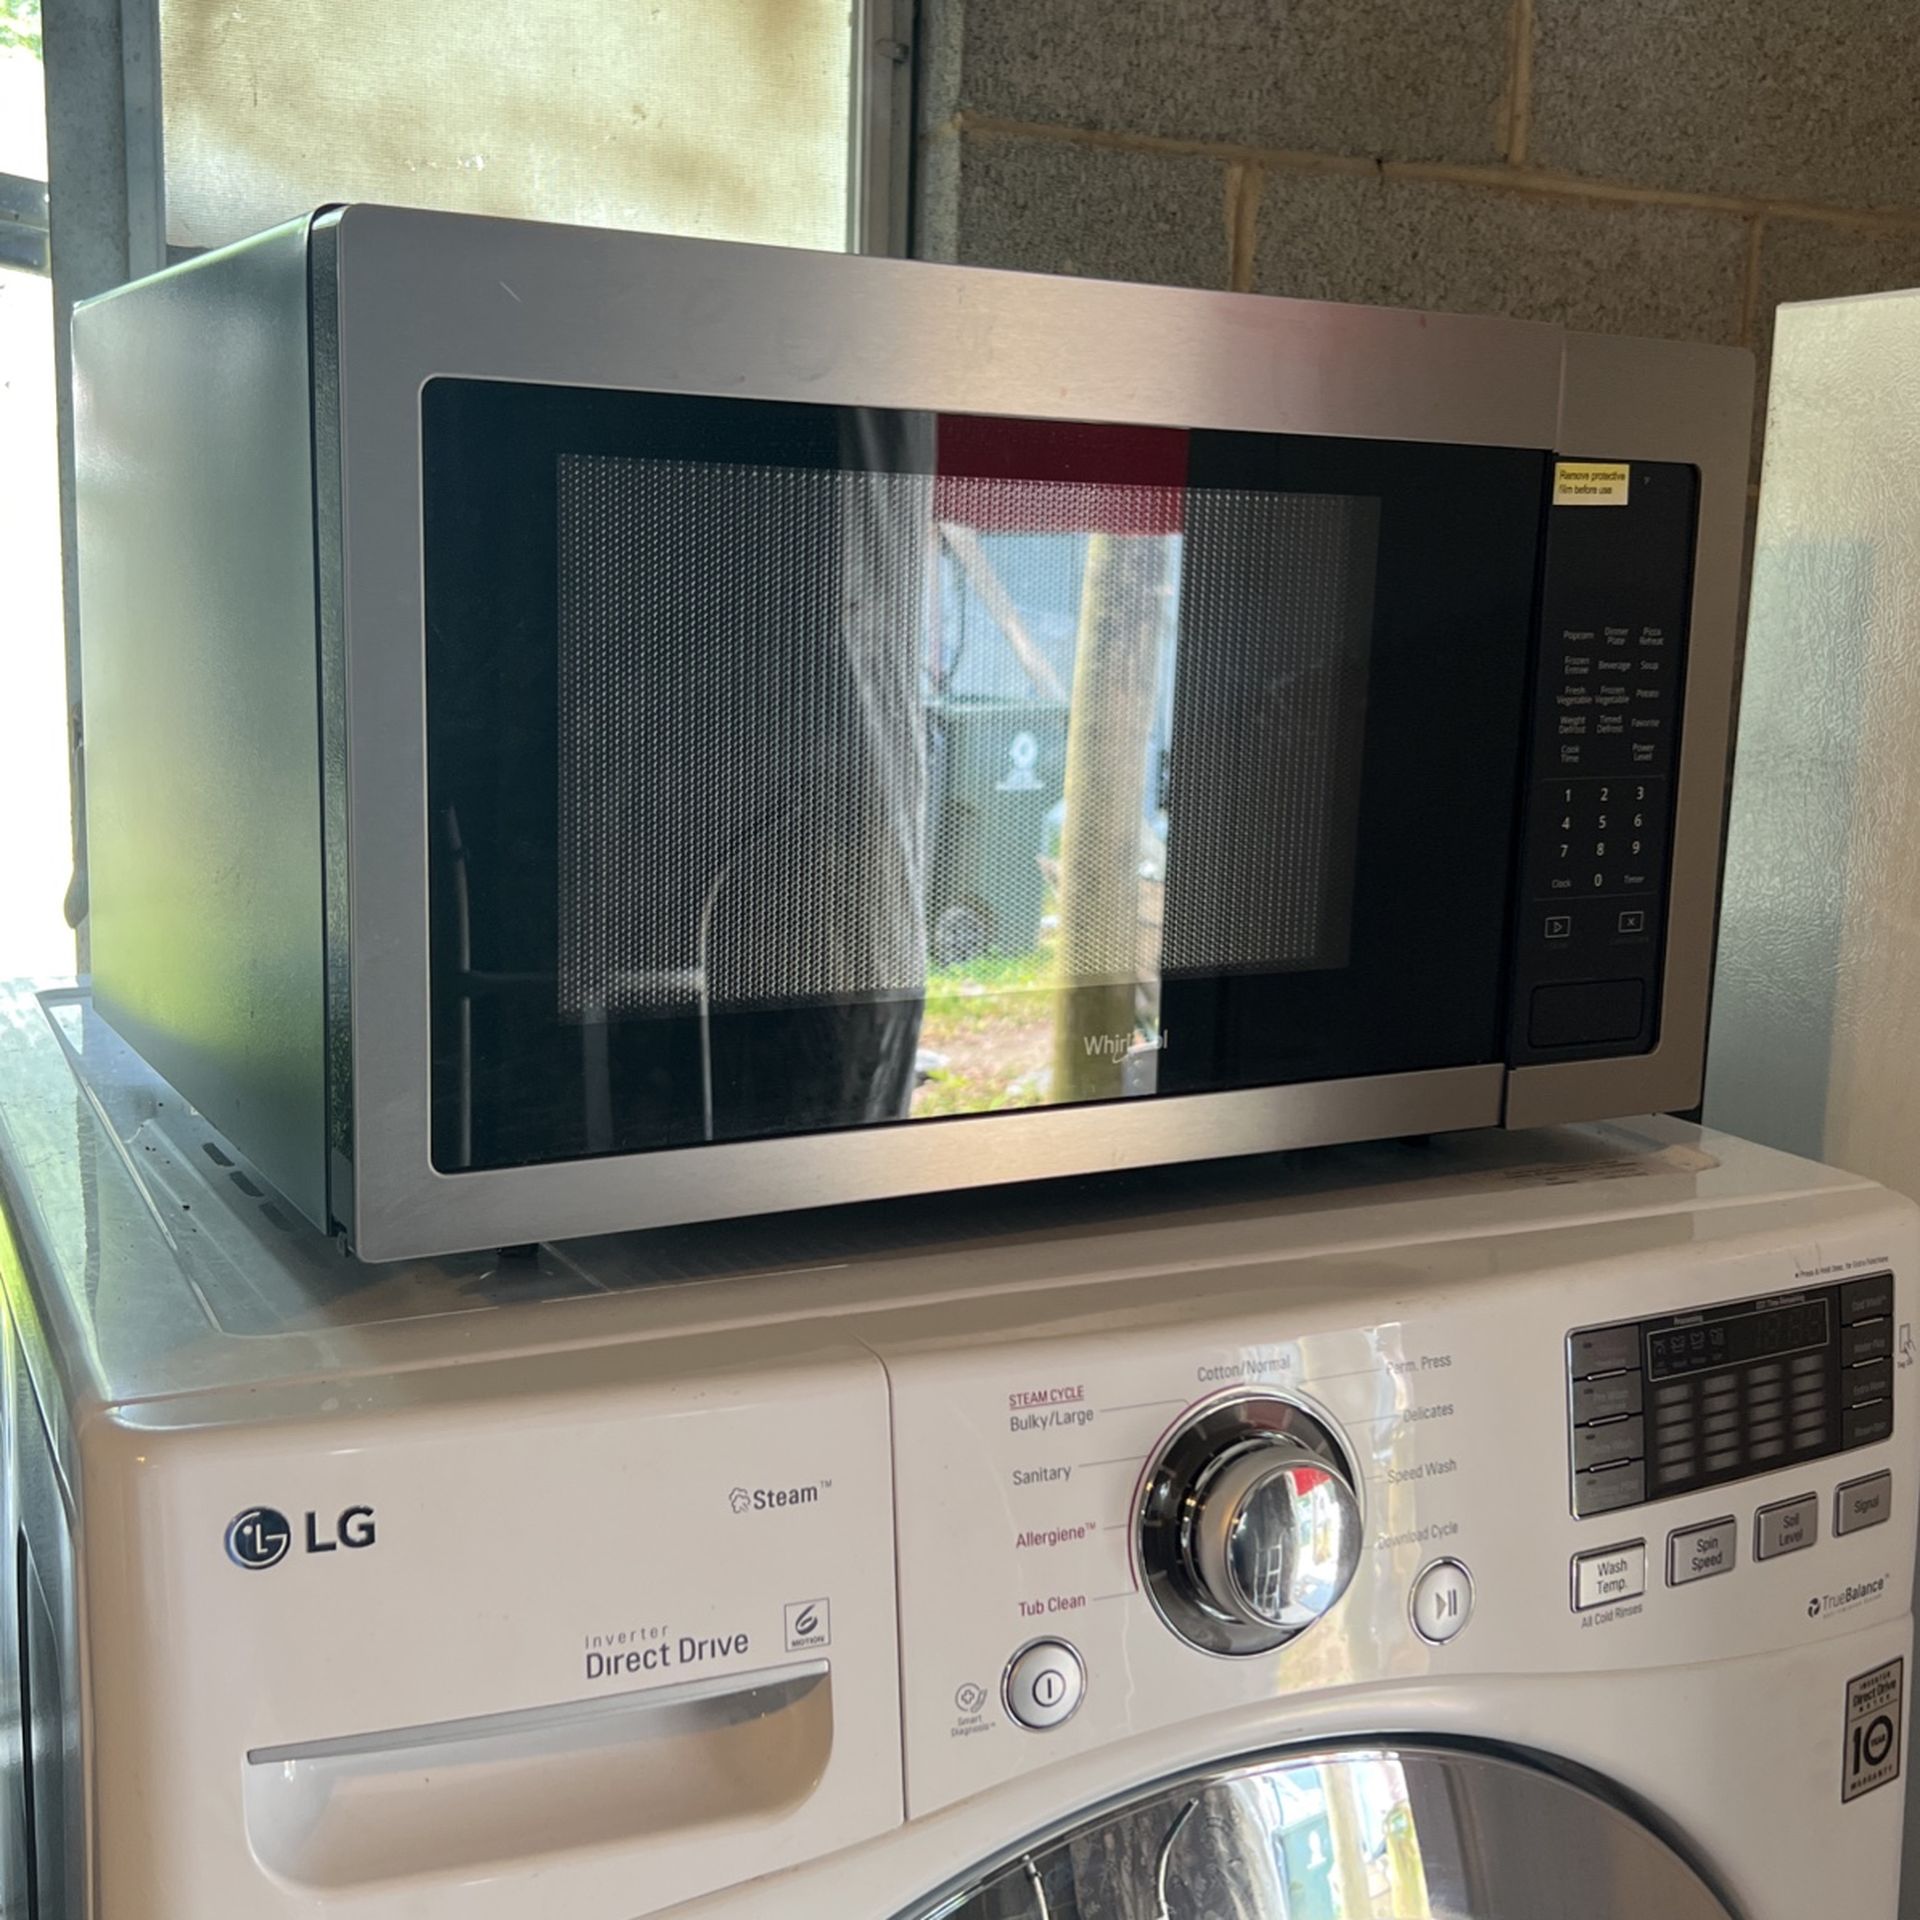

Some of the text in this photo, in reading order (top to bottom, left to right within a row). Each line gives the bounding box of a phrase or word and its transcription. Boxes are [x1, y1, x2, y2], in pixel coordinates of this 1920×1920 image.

[1560, 469, 1626, 483] Remove protective
[1559, 484, 1613, 494] film before use
[1563, 630, 1594, 641] Popcorn
[1598, 660, 1631, 672] Beverage
[1640, 660, 1660, 671] Soup
[1564, 788, 1572, 802] 1
[1600, 787, 1609, 802] 2
[1636, 786, 1644, 800] 3
[1561, 816, 1570, 830] 4
[1598, 815, 1607, 829] 5
[1634, 814, 1642, 828] 6
[1560, 844, 1568, 858] 7
[1596, 842, 1605, 856] 8
[1632, 840, 1640, 854] 9
[1551, 879, 1572, 889] Clock
[1594, 873, 1603, 888] 0
[1197, 1355, 1291, 1382] Cotton/Normal
[1421, 1353, 1452, 1370] Press
[1009, 1385, 1084, 1407] STEAM CYCLE
[1010, 1408, 1094, 1432] Bulky/Large
[1402, 1402, 1455, 1424] Delicates
[1013, 1465, 1072, 1486] Sanitary
[1387, 1458, 1458, 1485] Speed Wash
[1854, 1494, 1880, 1515] Signal
[305, 1505, 376, 1553] LG
[1783, 1512, 1801, 1529] Soil
[1431, 1521, 1458, 1541] Cycle
[1779, 1528, 1804, 1547] Level
[1697, 1536, 1720, 1554] Spin
[1597, 1558, 1628, 1577] Wash
[1691, 1551, 1724, 1572] Speed
[1597, 1578, 1628, 1596] Temp.
[1018, 1594, 1087, 1617] Tub Clean
[1595, 1608, 1614, 1626] Cold
[1615, 1602, 1643, 1621] Rinses
[584, 1624, 670, 1649] Inverter
[791, 1634, 825, 1648] MOTION
[586, 1633, 749, 1680] Direct Drive
[1853, 1680, 1897, 1708] Direct Drive
[958, 1714, 982, 1726] Smart
[1853, 1714, 1894, 1776] 10
